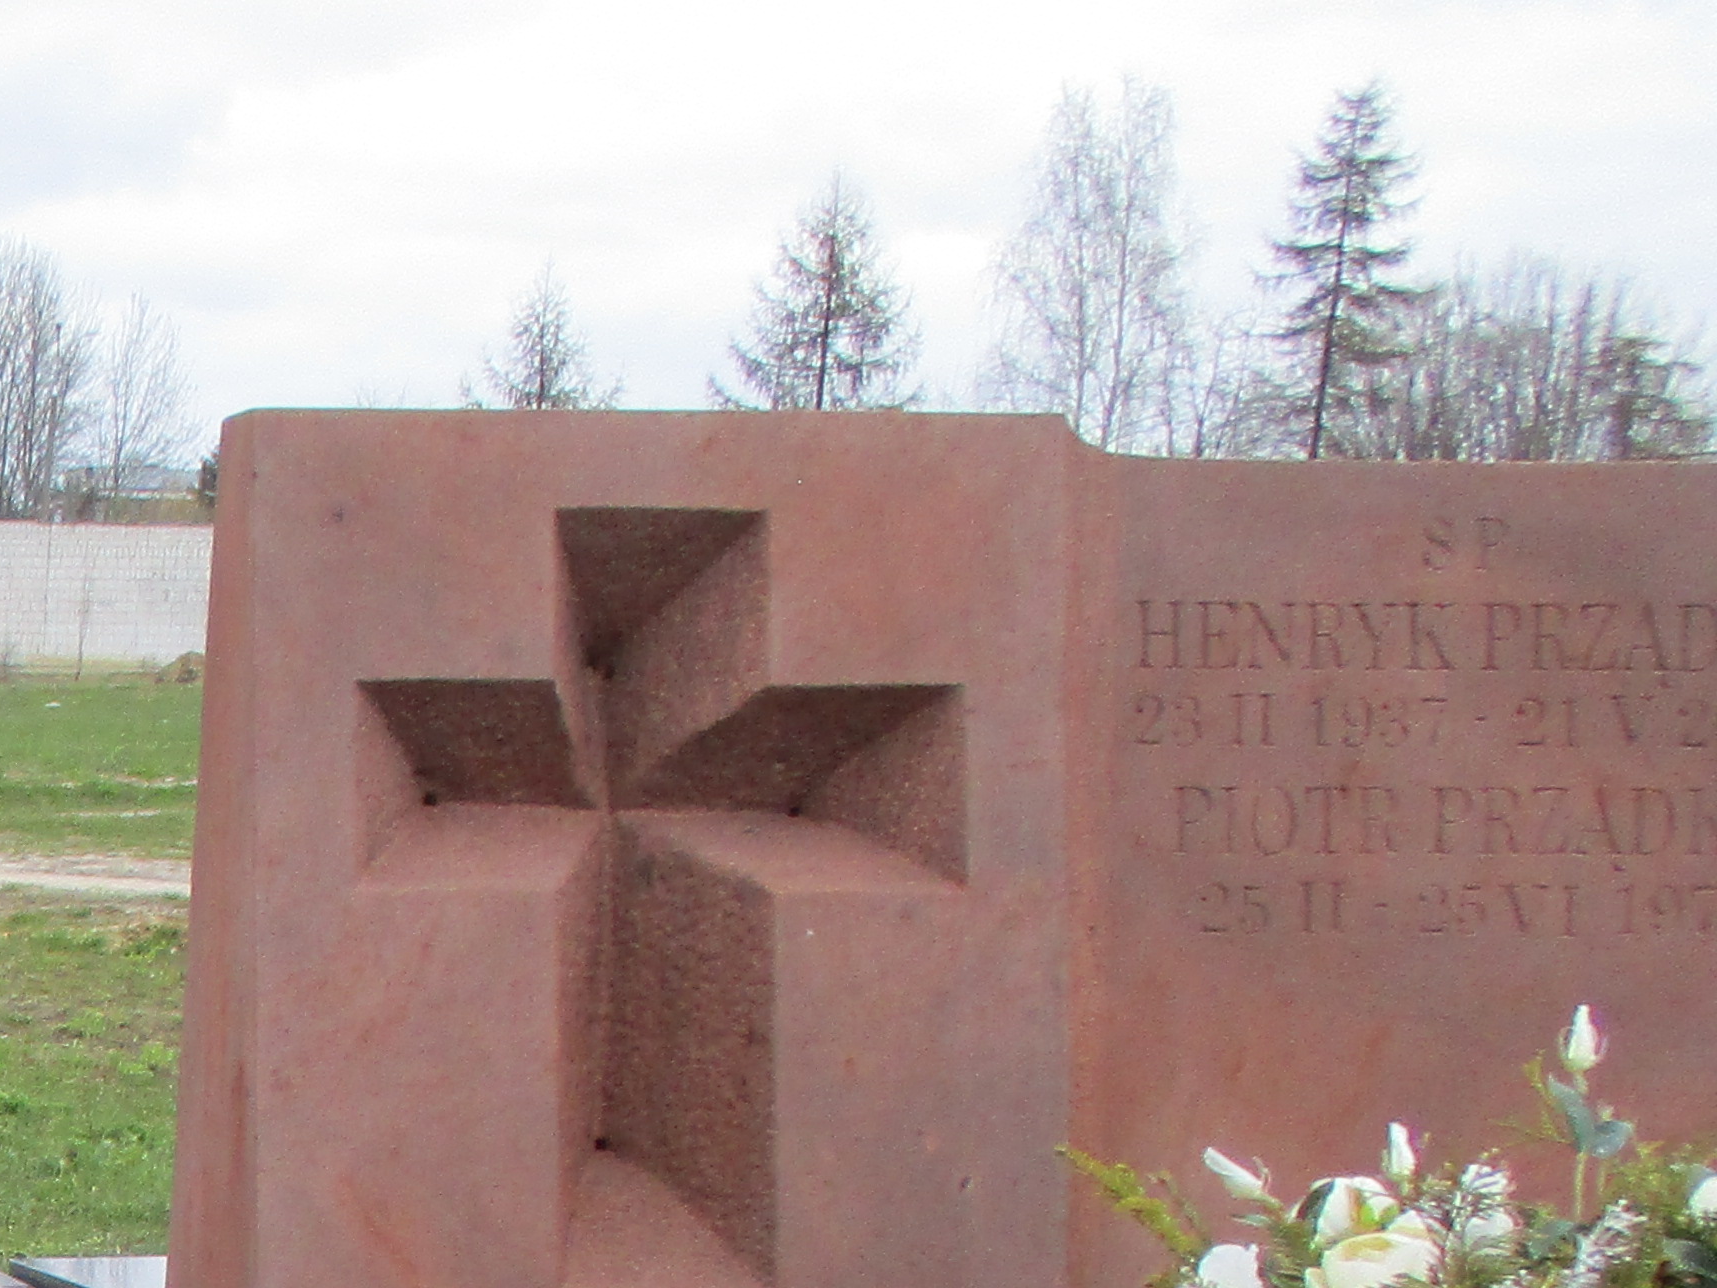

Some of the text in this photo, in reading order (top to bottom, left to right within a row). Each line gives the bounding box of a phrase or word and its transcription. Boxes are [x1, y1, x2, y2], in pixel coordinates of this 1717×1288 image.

[1474, 515, 1511, 572] P
[1135, 599, 1456, 670] HENRYK
[1133, 693, 1204, 747] 23
[1229, 692, 1276, 747] II
[1310, 694, 1449, 748] 1937
[1611, 693, 1654, 744] V
[1173, 785, 1400, 857] PIOTR
[1199, 884, 1271, 935] 25
[1297, 881, 1348, 935] II
[1415, 884, 1487, 937] 25
[1500, 884, 1580, 937] VI
